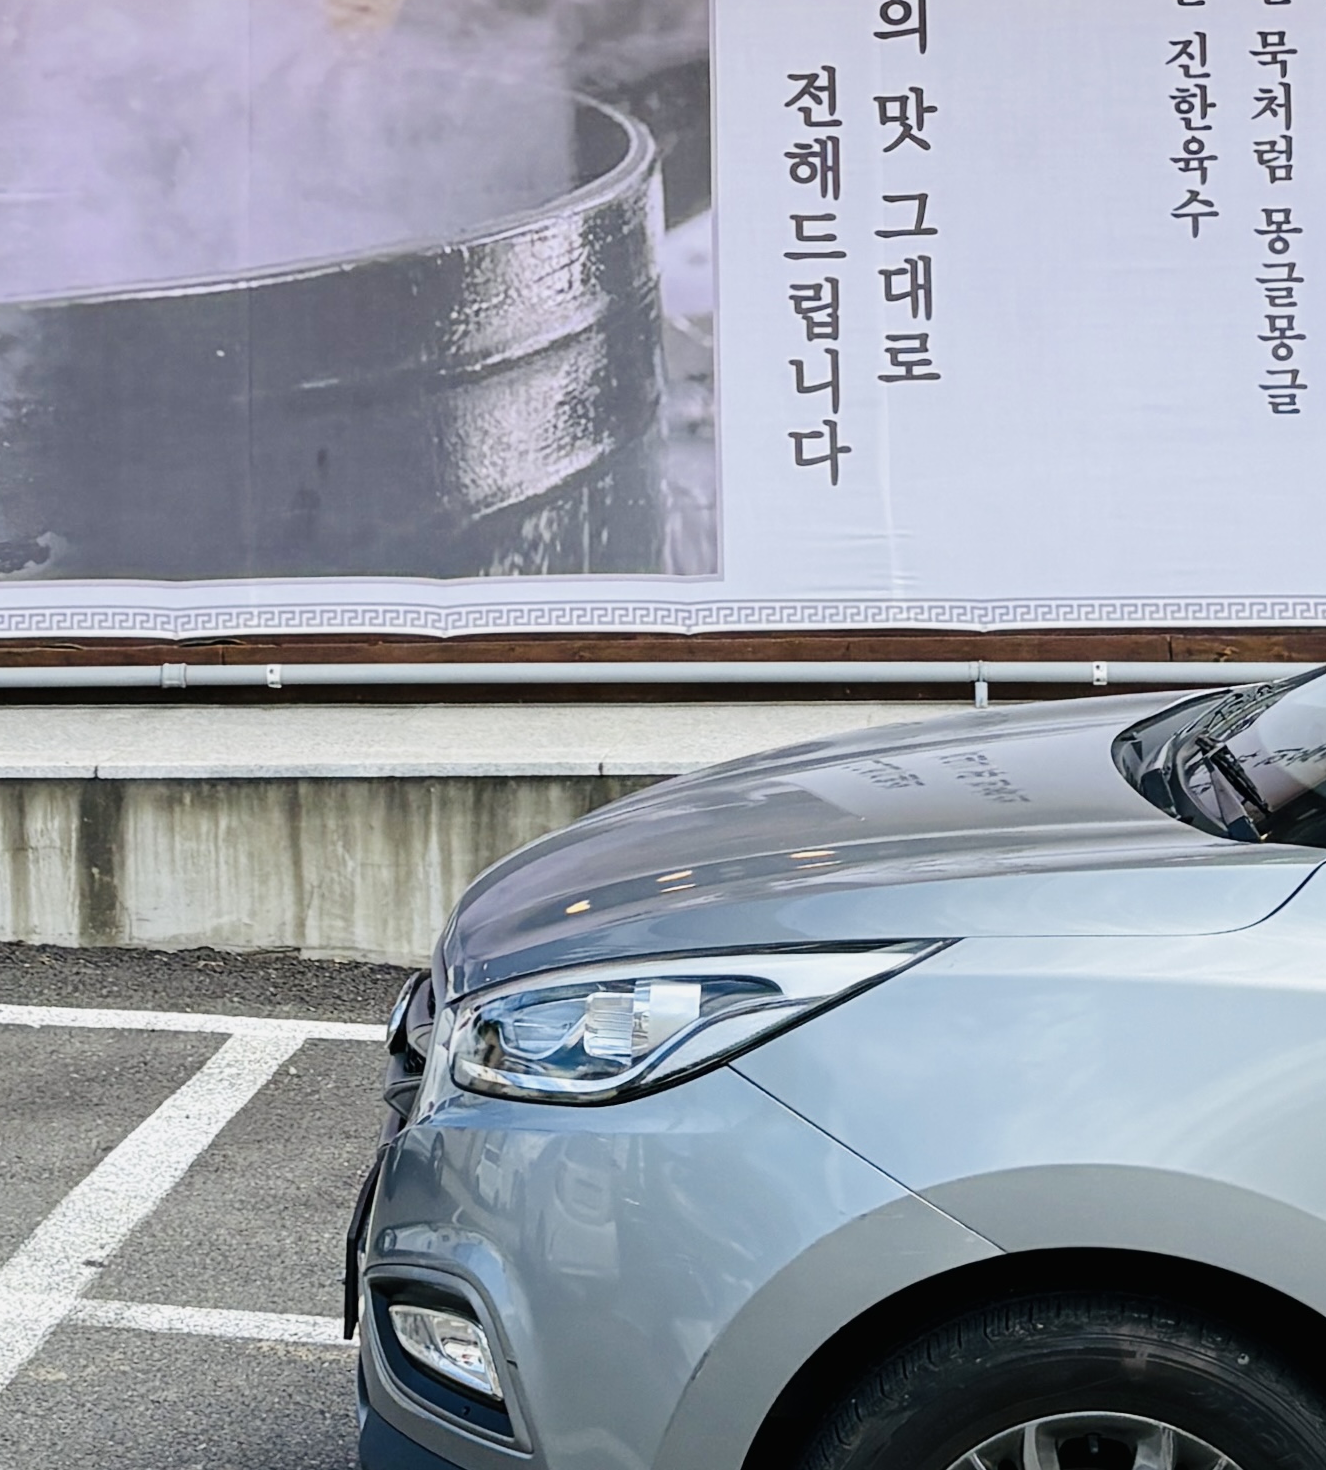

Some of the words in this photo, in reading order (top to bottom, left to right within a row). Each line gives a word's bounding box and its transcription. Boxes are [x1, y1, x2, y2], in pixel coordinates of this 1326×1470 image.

[873, 87, 938, 152] 맛
[1165, 31, 1219, 238] 진한육수
[1249, 31, 1298, 184] 묵처럼
[783, 65, 852, 486] 전해드립니다
[874, 193, 941, 383] 그대로
[1254, 208, 1308, 414] 몽글몽글
